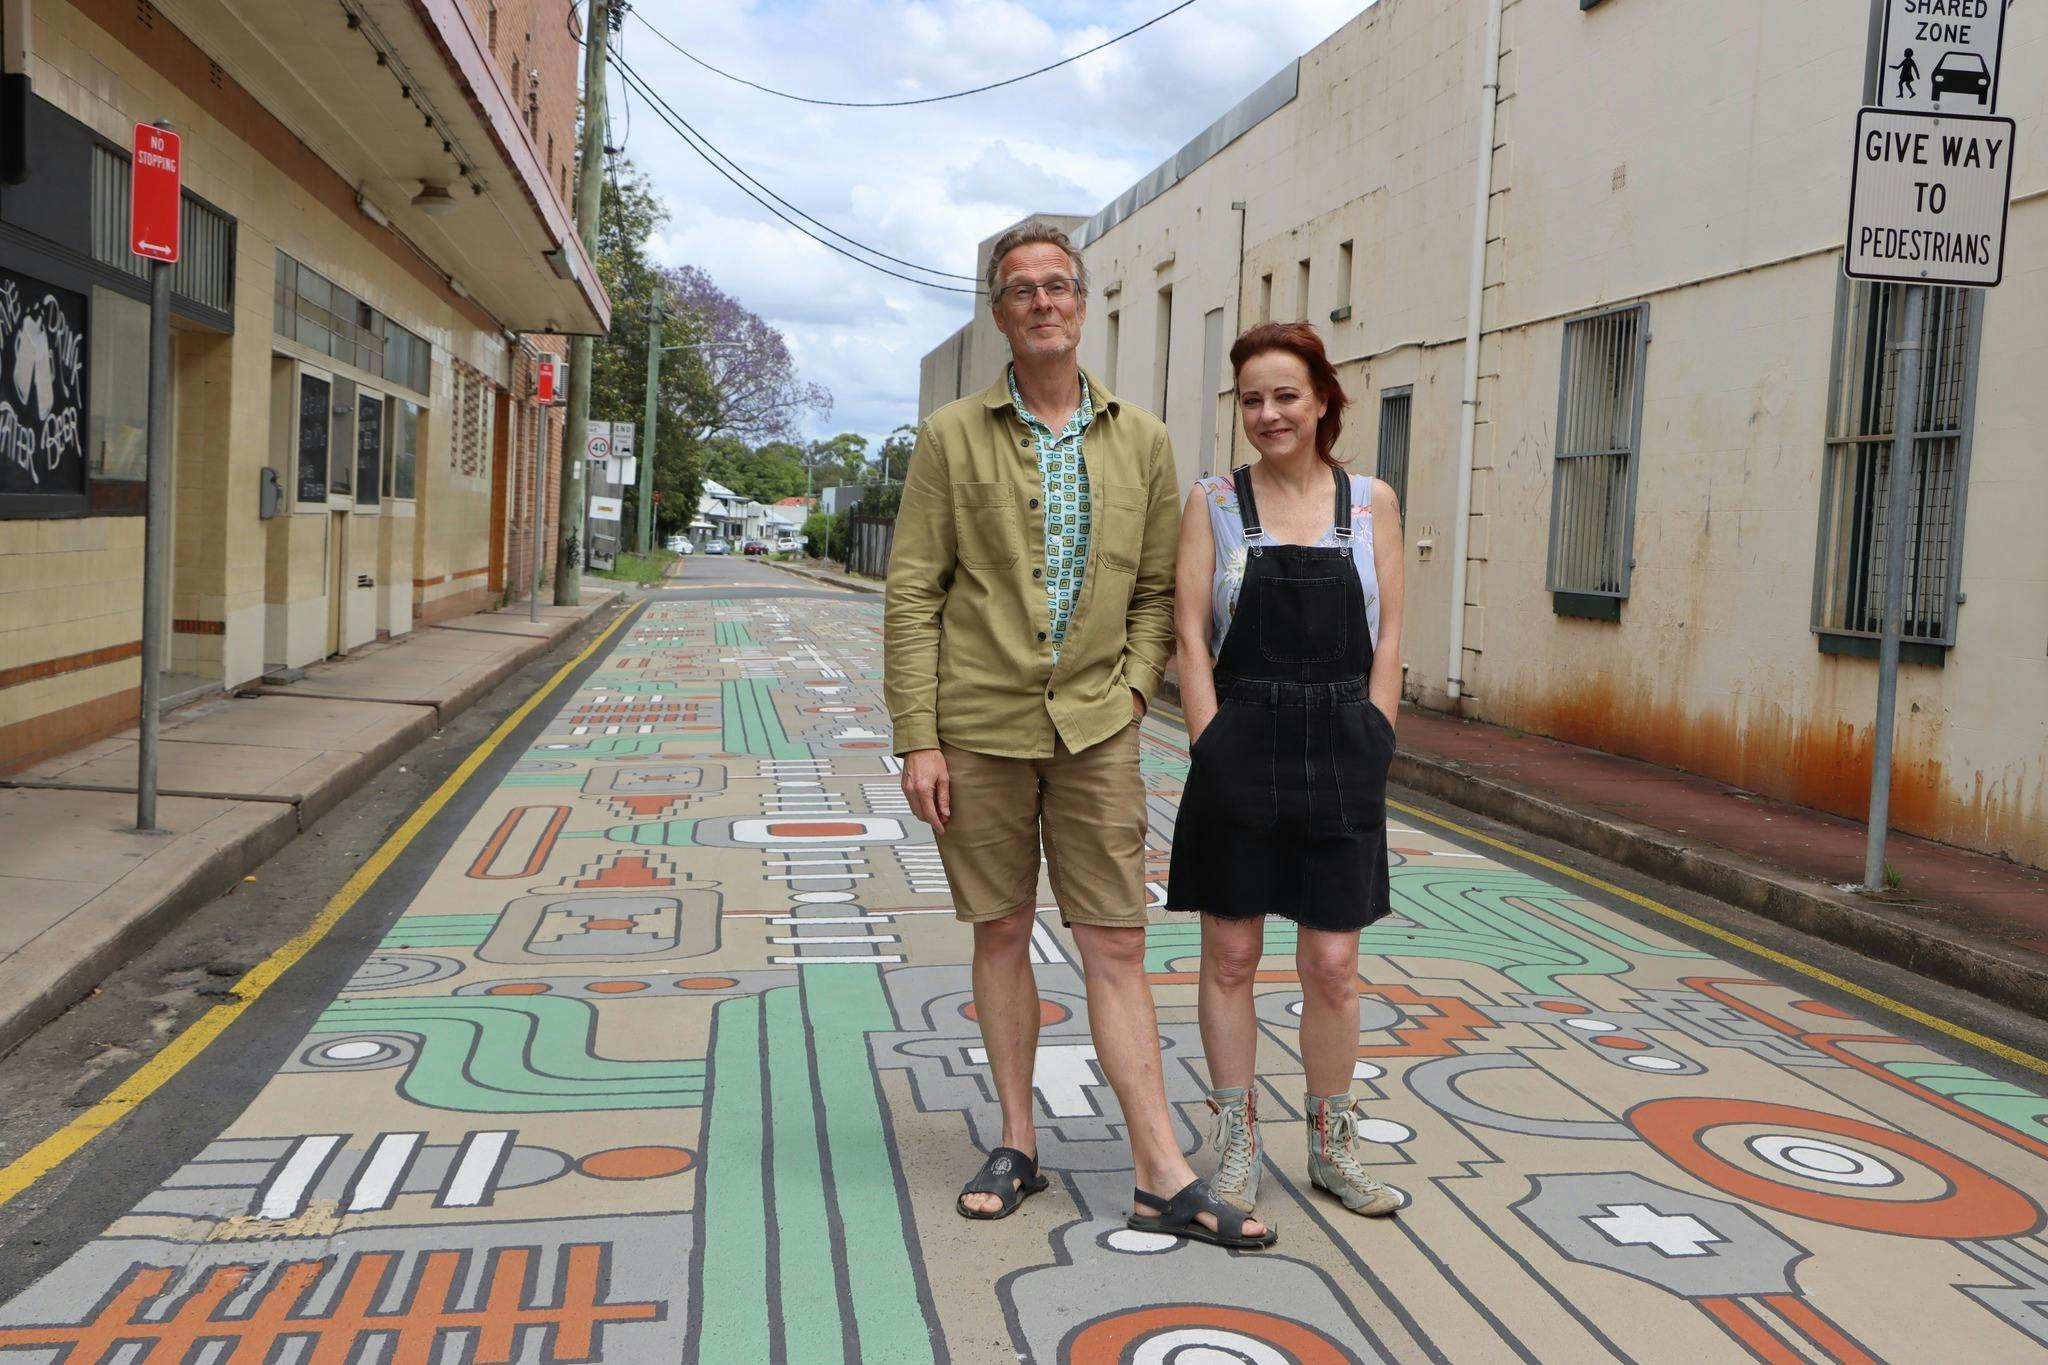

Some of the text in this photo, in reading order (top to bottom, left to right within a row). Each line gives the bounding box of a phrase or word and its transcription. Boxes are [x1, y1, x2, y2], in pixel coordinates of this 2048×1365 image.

[1904, 0, 1988, 18] SHARED
[1915, 21, 1972, 44] ZONE
[150, 135, 165, 151] NO
[1866, 129, 2003, 170] GIVE WAY
[138, 150, 177, 173] STOPPING
[1914, 181, 1947, 215] TO
[1860, 226, 1991, 266] PEDESTRIANS
[43, 294, 83, 410] DRINK
[0, 401, 40, 485] ATER
[40, 406, 82, 472] BEER
[592, 442, 607, 453] 40
